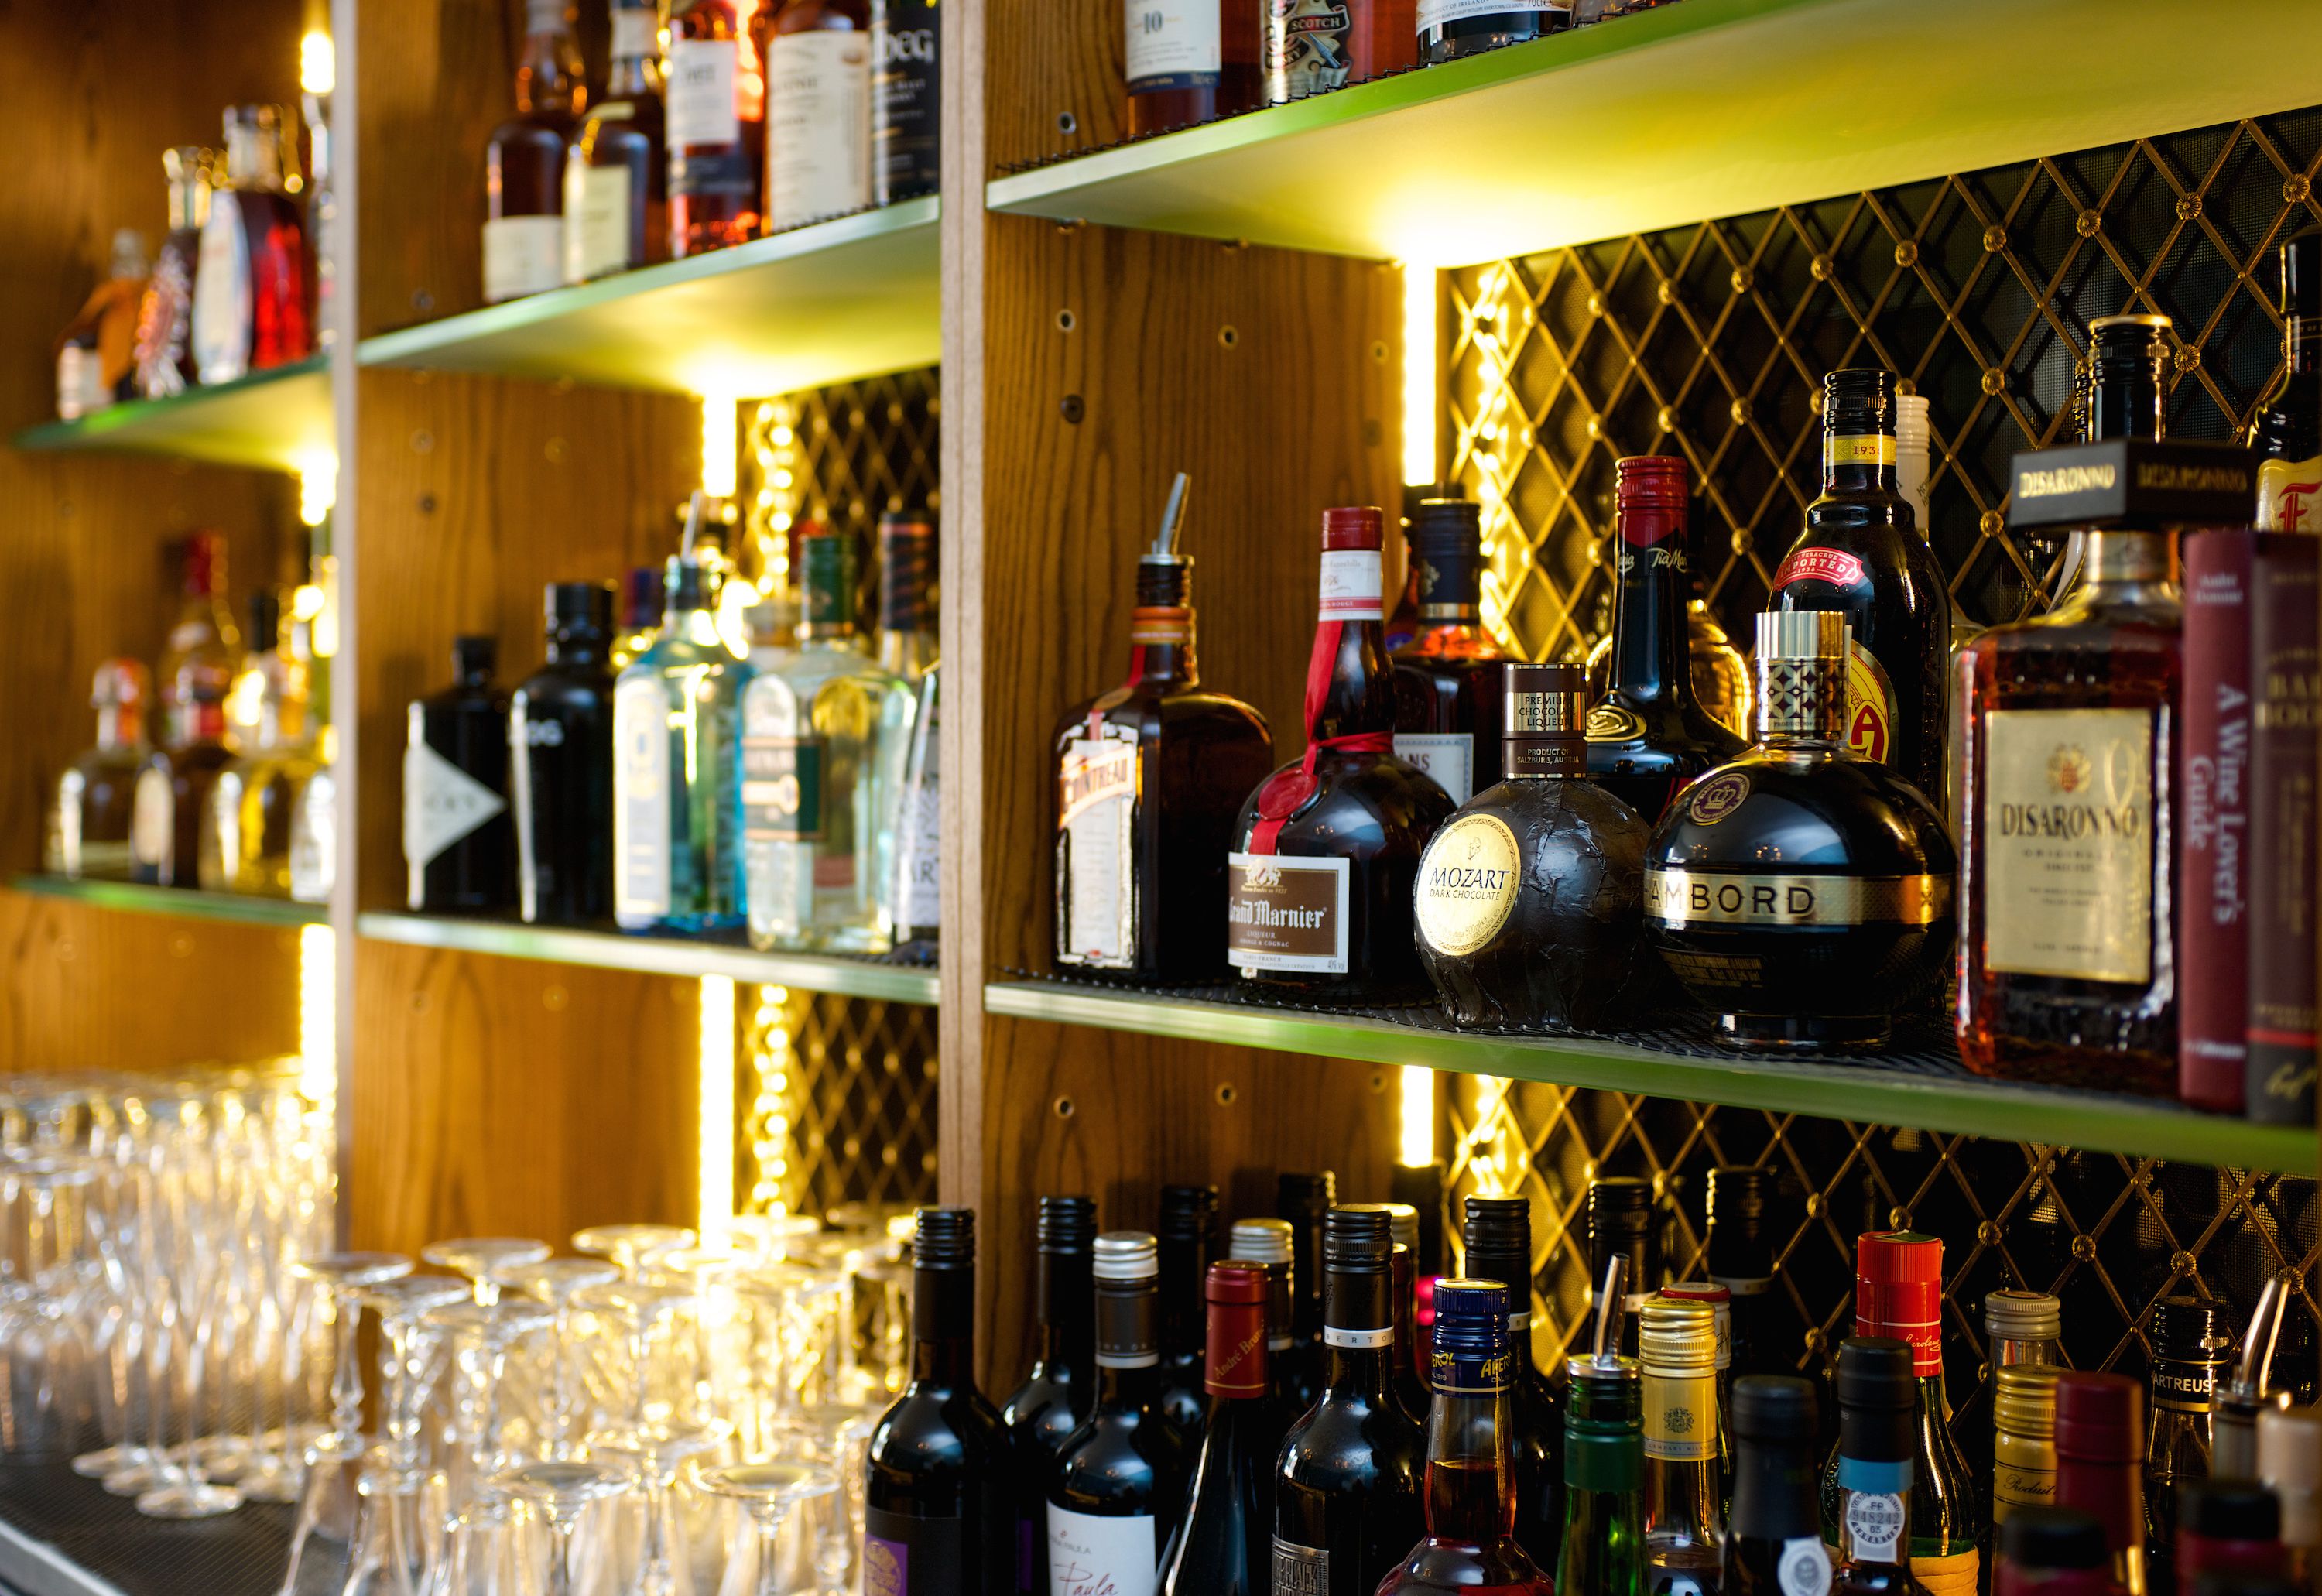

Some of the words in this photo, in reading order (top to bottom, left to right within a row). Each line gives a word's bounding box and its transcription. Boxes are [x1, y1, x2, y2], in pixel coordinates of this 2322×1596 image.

[1144, 10, 1163, 34] 10
[1291, 15, 1341, 31] SCOTCH
[2019, 463, 2115, 499] DISARONNO
[1779, 557, 1847, 578] IMPORTED
[1525, 697, 1568, 706] PREMIU
[2000, 803, 2141, 841] DISARONNO
[1429, 866, 1510, 890] MOZART
[1430, 889, 1450, 899] DARK
[1452, 889, 1500, 901] CHOCOLATE
[1254, 899, 1324, 929] Marnier
[1870, 1502, 1883, 1511] FP
